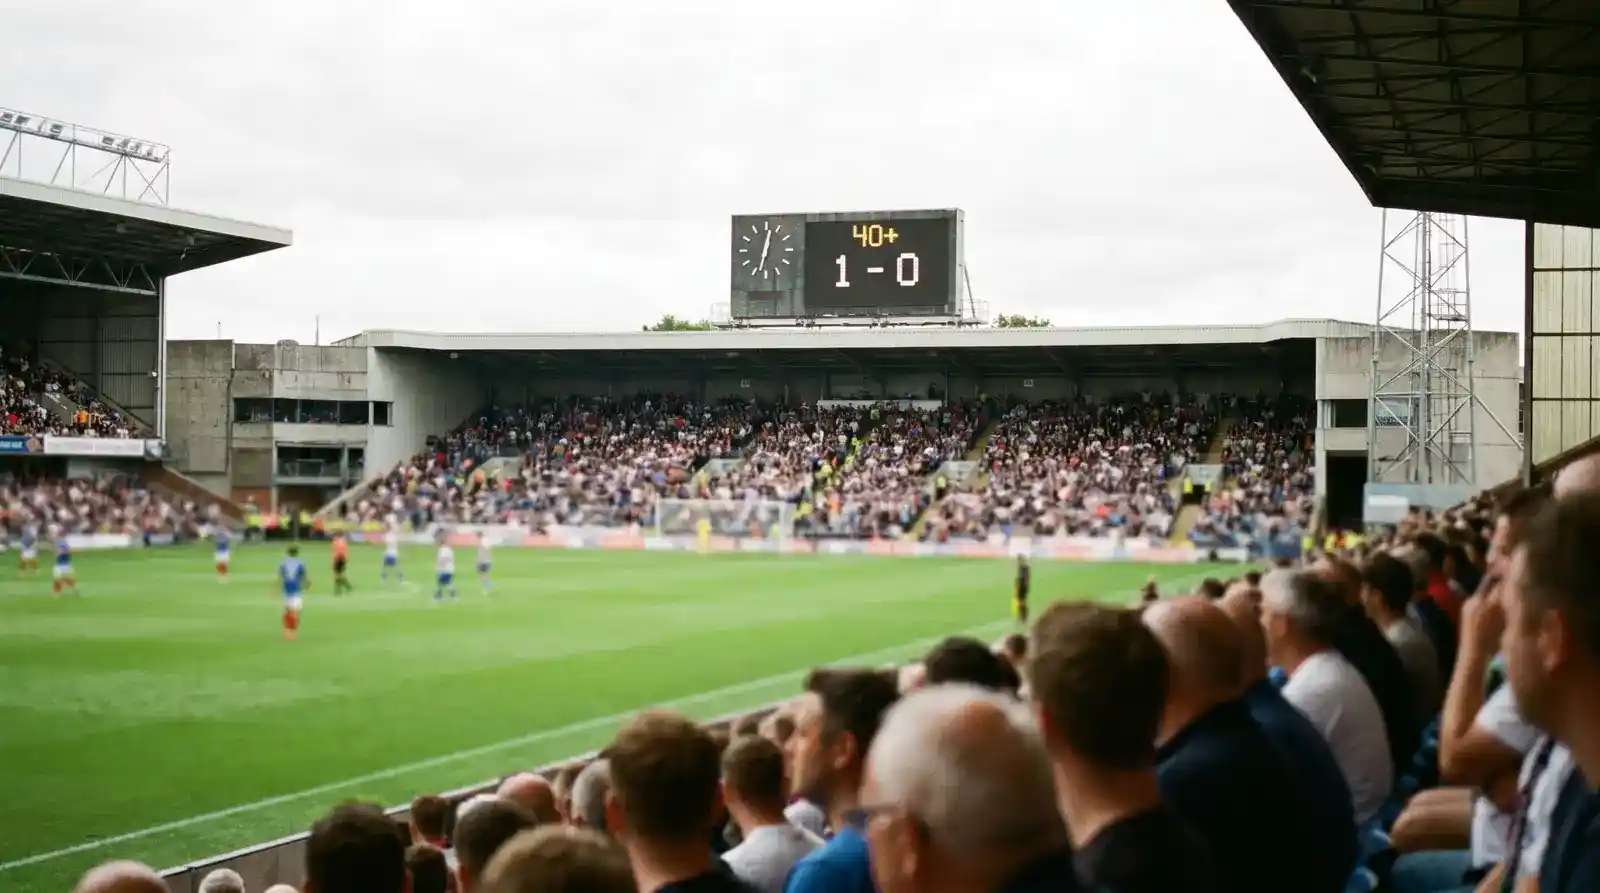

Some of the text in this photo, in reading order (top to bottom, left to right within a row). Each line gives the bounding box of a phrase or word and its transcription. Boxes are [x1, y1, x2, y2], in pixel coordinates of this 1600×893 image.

[852, 224, 899, 247] 40+
[835, 254, 850, 287] 1
[897, 252, 919, 286] 0
